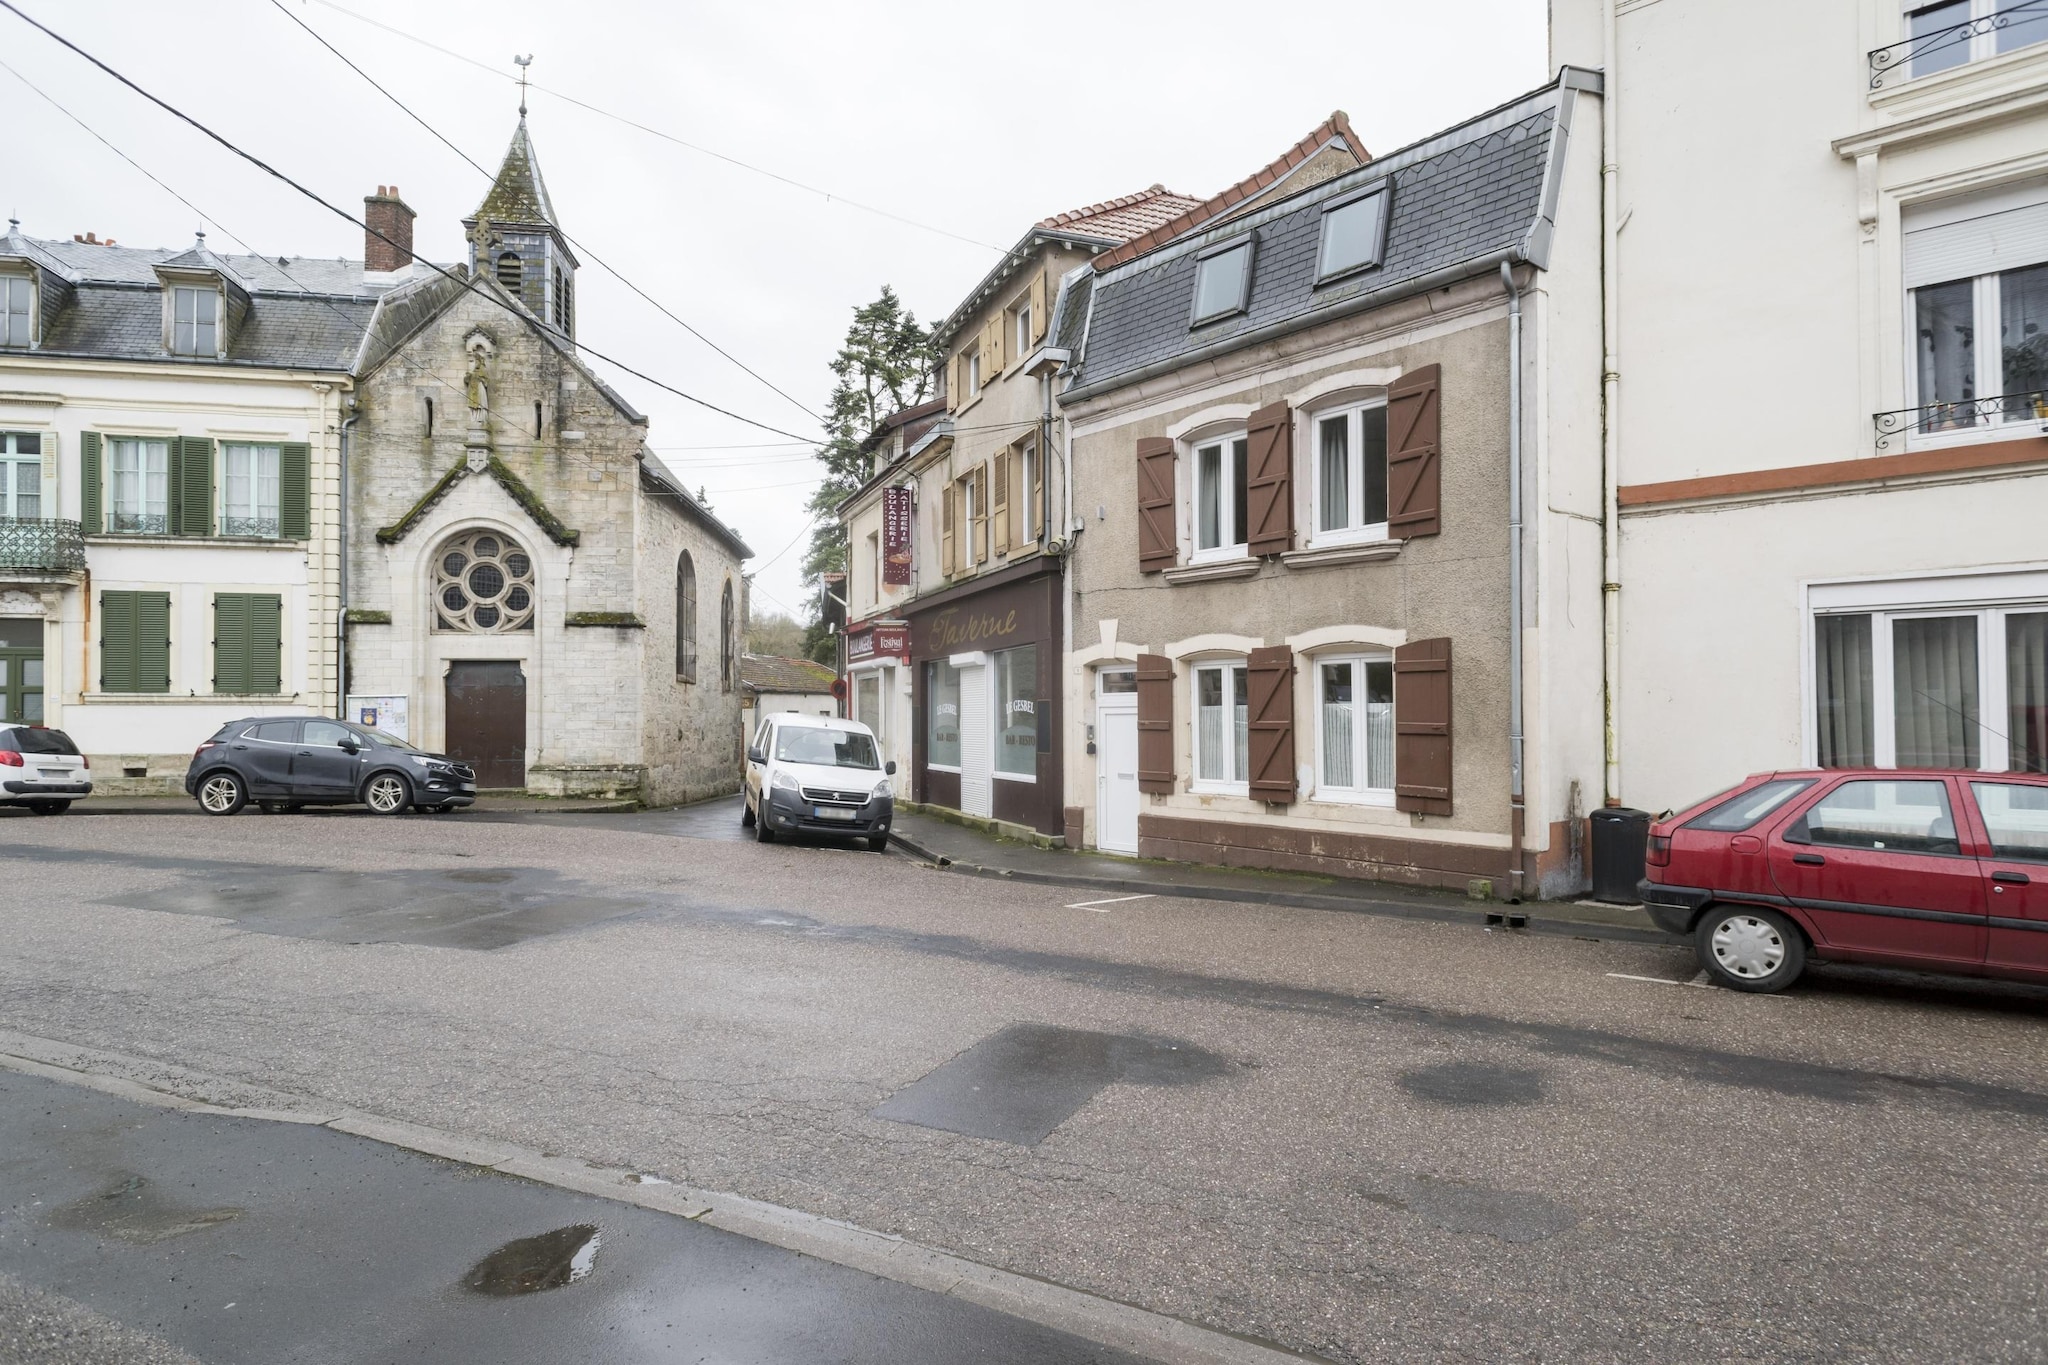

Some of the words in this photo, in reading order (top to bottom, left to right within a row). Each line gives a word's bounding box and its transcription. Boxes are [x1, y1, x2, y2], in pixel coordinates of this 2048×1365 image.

[929, 608, 1016, 651] Taverne
[880, 636, 902, 648] Festival
[1006, 702, 1013, 714] LE
[1013, 700, 1034, 714] GESBEL
